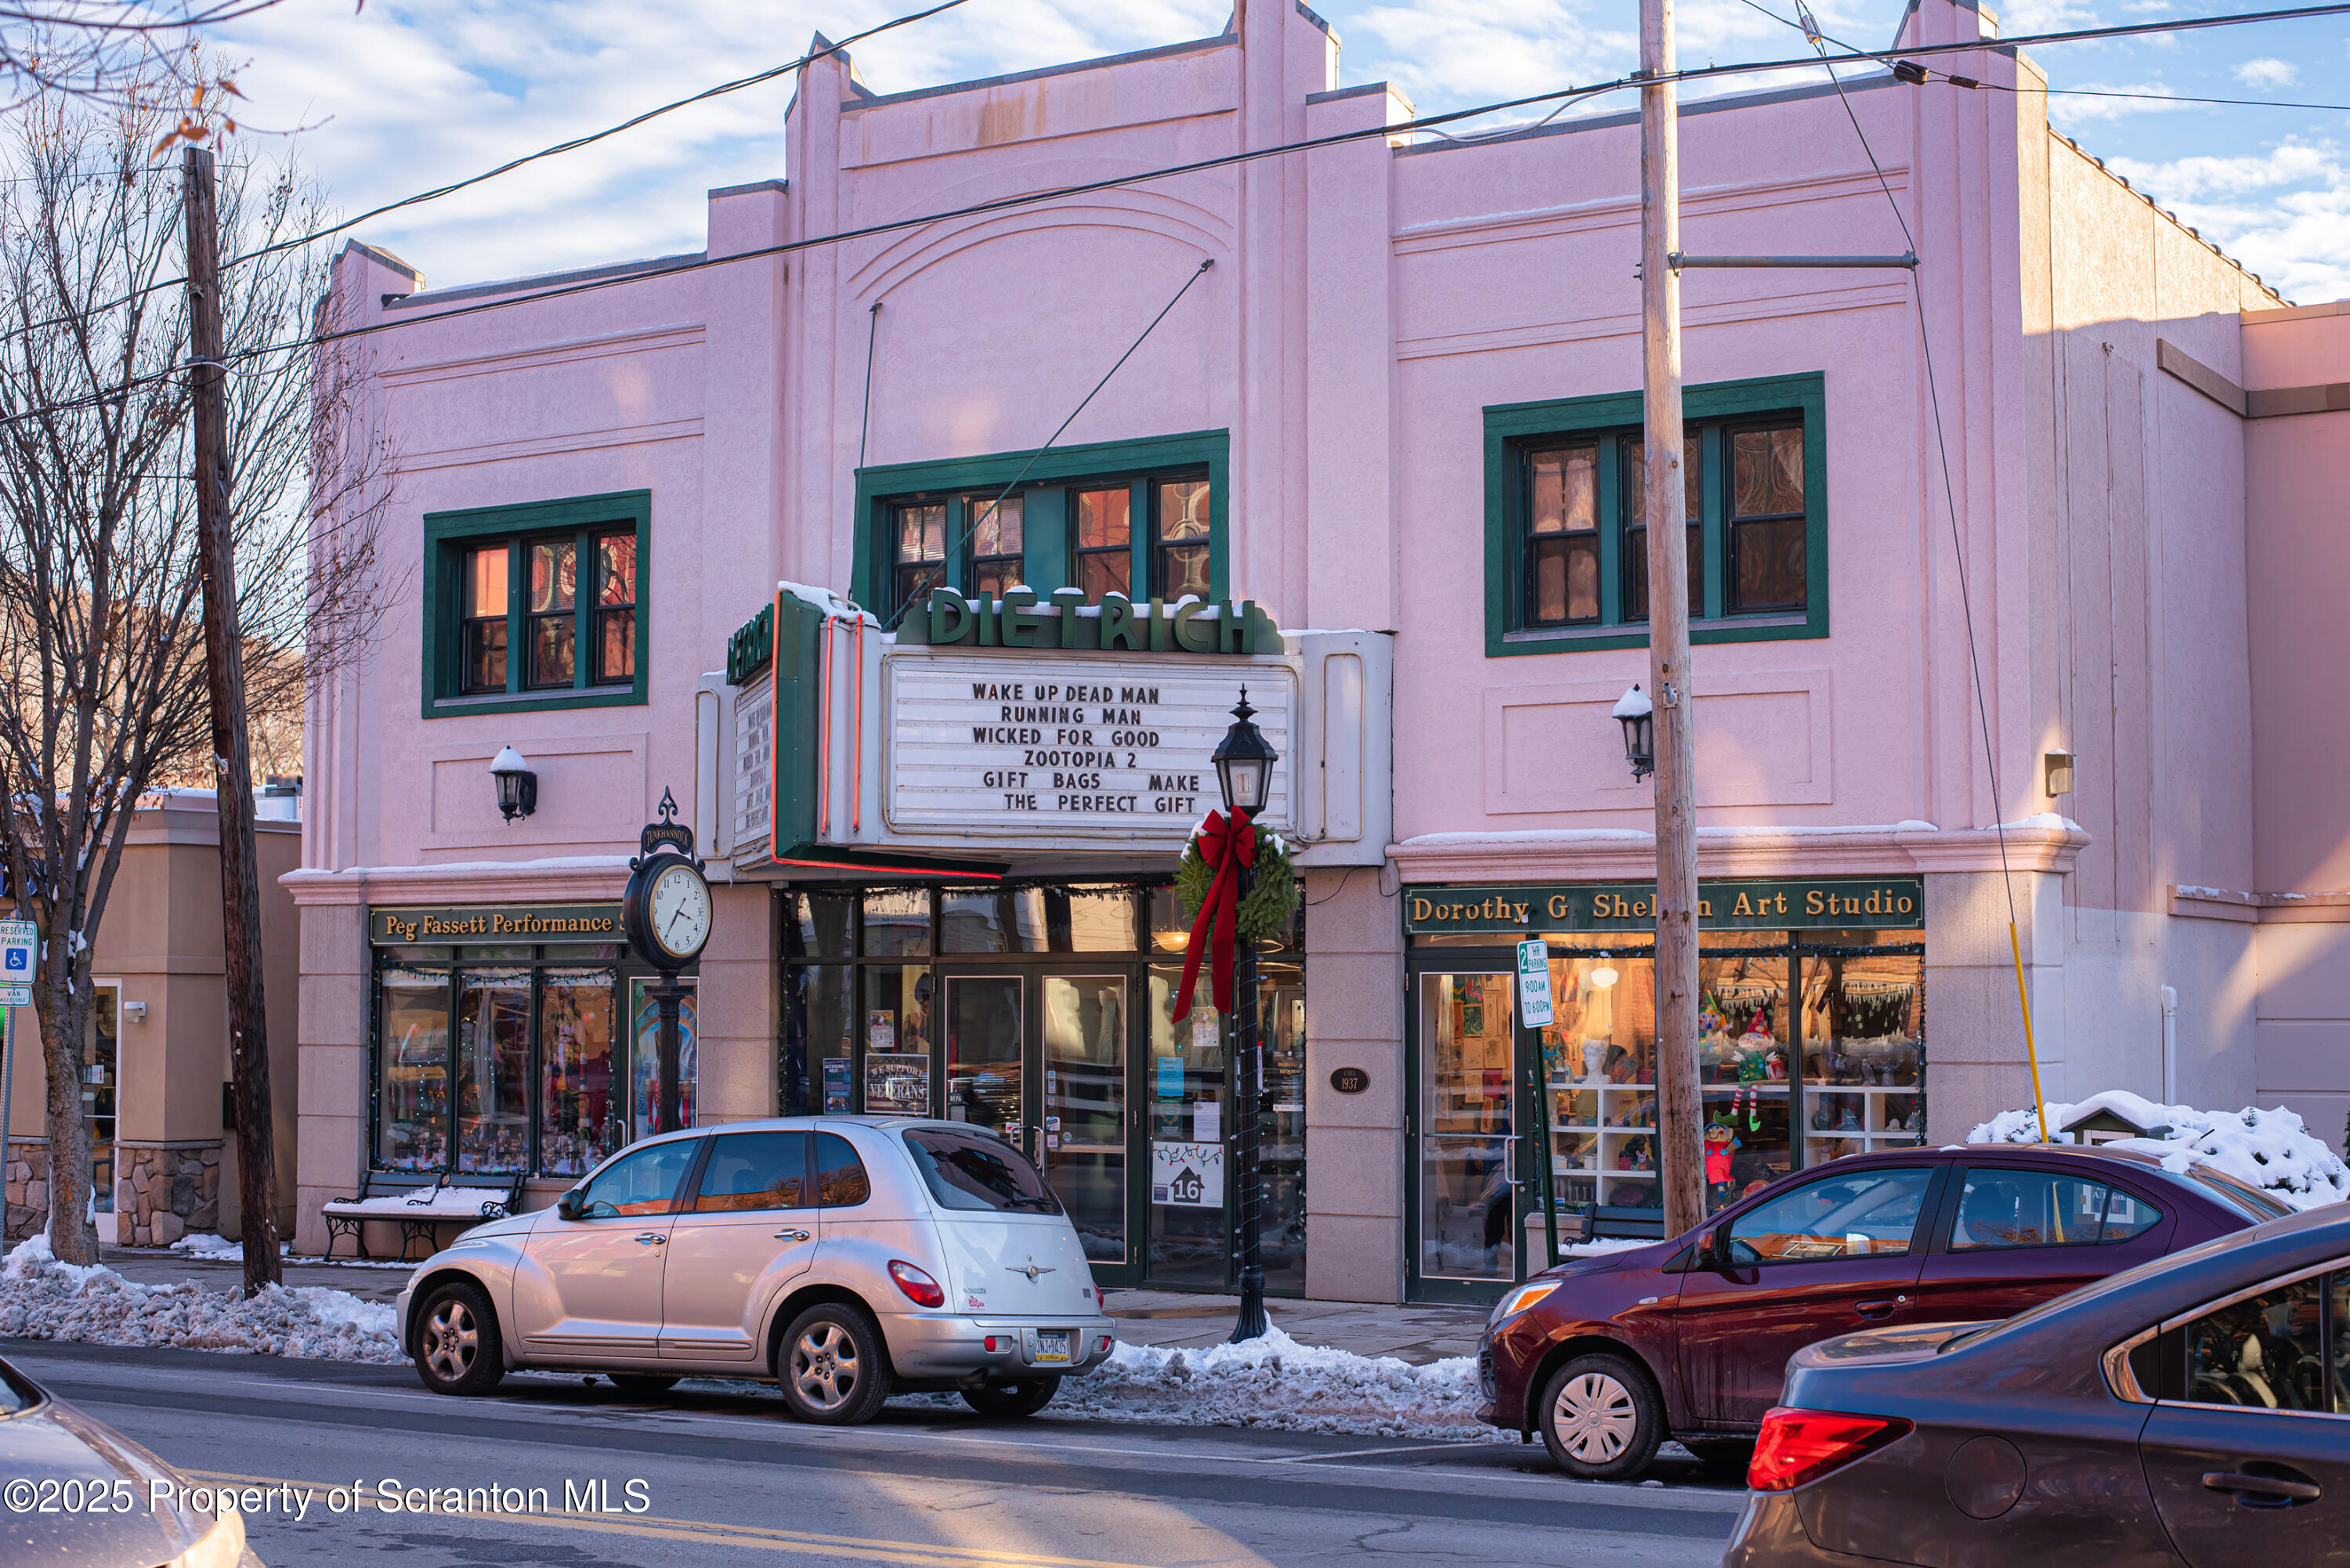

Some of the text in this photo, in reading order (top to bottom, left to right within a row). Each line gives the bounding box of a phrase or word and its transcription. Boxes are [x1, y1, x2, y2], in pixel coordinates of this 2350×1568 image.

[931, 589, 1256, 654] DIETRICH
[973, 684, 1159, 704] WAKE UP DEAD MAN
[1002, 706, 1141, 725] RUNNING MAN
[973, 728, 1159, 747] WICKED FOR GOOD
[1025, 750, 1136, 768] ZOOTOPIA 2
[983, 771, 1198, 791] GIFT BAGS MAKE
[1004, 794, 1195, 813] THE PERFECT GIFT
[646, 829, 689, 847] TUNKHANNOCK
[664, 879, 670, 888] 11
[674, 875, 681, 884] 12
[686, 880, 690, 889] 1
[656, 891, 663, 900] 10
[694, 891, 698, 900] 2
[697, 908, 702, 917] 3
[1413, 889, 1913, 924] Dorothy G Sheln Art Studio
[1, 927, 33, 936] RESERVED
[386, 916, 418, 941] Peg
[423, 915, 486, 934] Fassett
[492, 913, 613, 933] Performance
[656, 923, 661, 933] 8
[693, 923, 698, 933] 4
[1, 937, 33, 946] PARKING
[674, 940, 680, 949] 6
[686, 936, 690, 945] 5
[1532, 946, 1540, 956] HR
[1520, 948, 1528, 970] 2
[1529, 957, 1546, 970] PARKING
[1524, 1002, 1531, 1014] TO
[870, 1064, 924, 1078] WE SUPPORT
[1342, 1078, 1358, 1090] 1937
[870, 1083, 924, 1100] VETERANS
[1175, 1180, 1199, 1199] 16
